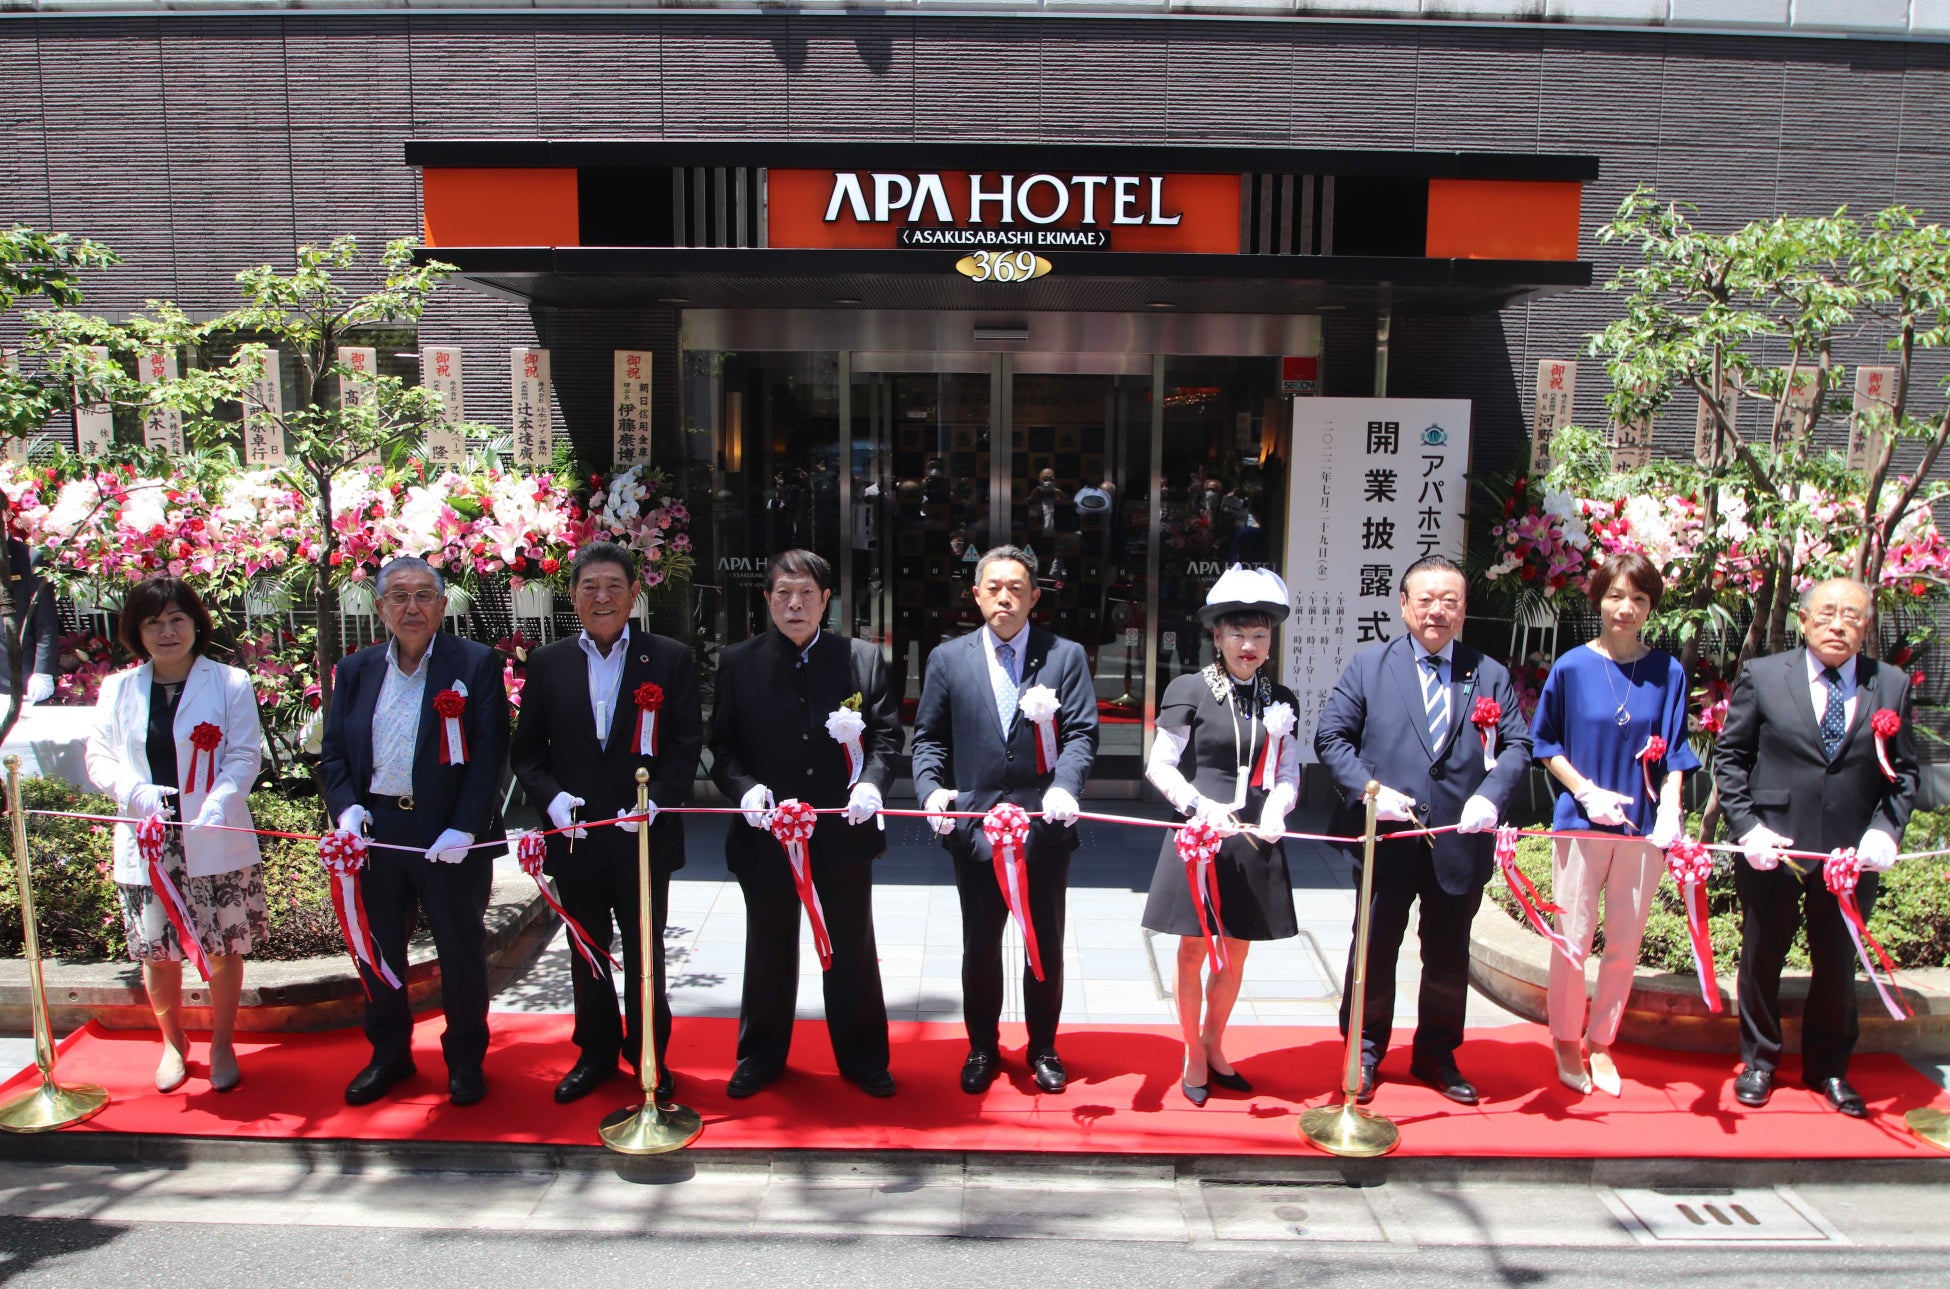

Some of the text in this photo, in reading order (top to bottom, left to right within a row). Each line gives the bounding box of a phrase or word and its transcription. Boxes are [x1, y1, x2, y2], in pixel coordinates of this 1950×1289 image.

[823, 173, 1182, 225] APA HOTEL
[971, 249, 1038, 284] 369
[435, 351, 450, 377] 御祝
[523, 352, 539, 378] 御祝
[626, 354, 641, 380] 御祝
[1549, 363, 1565, 390] 御祝
[1284, 381, 1316, 390] SECOM
[1867, 372, 1882, 396] 御祝
[638, 383, 649, 458] 朝日信用金庫
[1416, 455, 1445, 558] アパホテ
[1356, 420, 1401, 644] 開業披露式
[717, 557, 752, 571] APA
[1186, 561, 1221, 575] APA
[1303, 690, 1314, 747] テープカット
